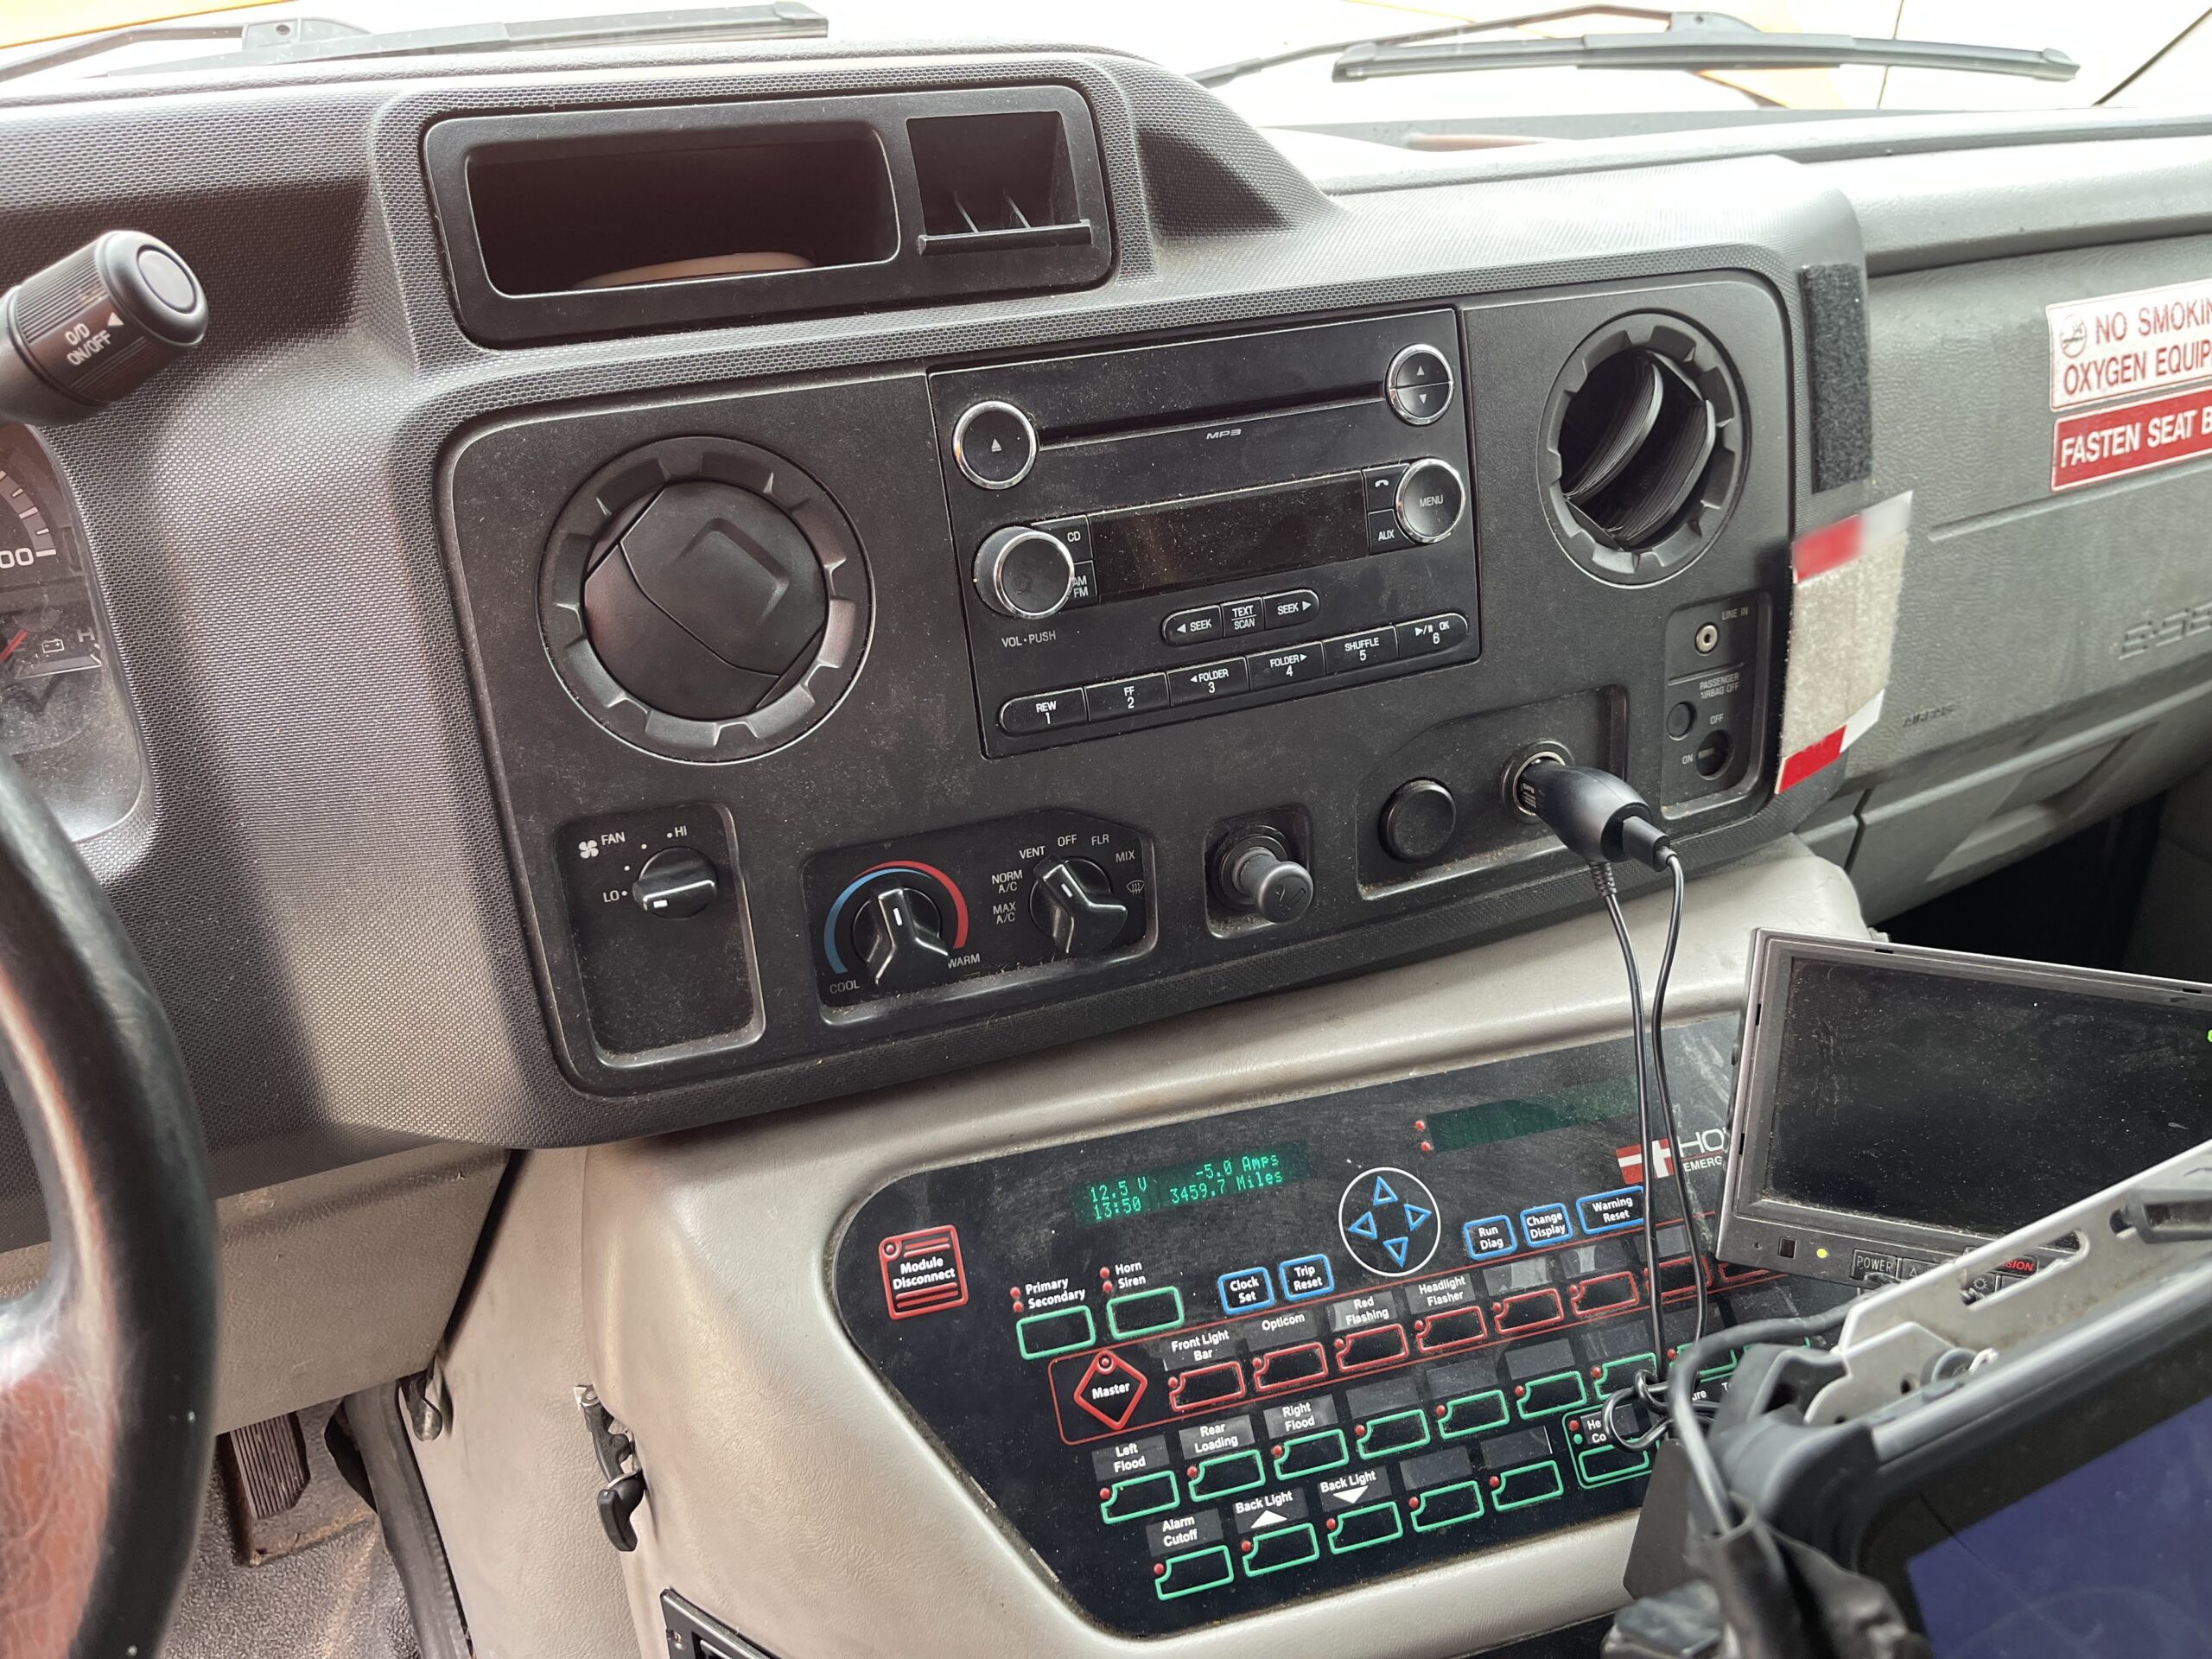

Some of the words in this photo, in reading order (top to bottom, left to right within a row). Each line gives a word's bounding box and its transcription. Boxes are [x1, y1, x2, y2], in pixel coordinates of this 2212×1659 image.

[65, 322, 91, 346] O/D
[2094, 311, 2127, 345] NO
[67, 329, 111, 365] ON/OFF
[2063, 351, 2146, 396] OXYGEN
[1206, 428, 1242, 440] MP3
[2060, 422, 2142, 468] FASTEN
[2146, 409, 2198, 448] SEAT
[1419, 494, 1444, 508] MENU
[1066, 531, 1081, 543] CD
[1377, 529, 1395, 542] AUX
[1071, 575, 1087, 588] AM
[1073, 587, 1089, 598] FM
[1232, 605, 1254, 618] TEXT
[1277, 602, 1299, 616] SEEK
[1721, 608, 1738, 620] LINE
[1740, 607, 1749, 616] IN
[1190, 619, 1212, 632] SEEK
[1234, 618, 1255, 631] SCAN
[1439, 620, 1450, 631] OK
[77, 626, 96, 643] H
[1432, 632, 1440, 645] 6
[1344, 637, 1380, 652] SHUFFLE
[1269, 653, 1300, 668] FOLDER
[1359, 650, 1367, 662] 5
[1198, 668, 1230, 683] FOLDER
[1285, 664, 1294, 677] 4
[1208, 682, 1216, 694] 3
[1700, 672, 1740, 691] PASSENGER
[1726, 682, 1740, 694] OFF
[1124, 686, 1135, 696] FF
[1036, 700, 1057, 714] REW
[1127, 696, 1135, 709] 2
[1045, 712, 1052, 725] 1
[1710, 713, 1724, 725] OFF
[1681, 755, 1694, 765] ON
[601, 831, 626, 846] FAN
[674, 825, 689, 837] HI
[1056, 833, 1078, 849] OFF
[1090, 833, 1110, 847] FLR
[1019, 845, 1046, 860] VENT
[1115, 849, 1136, 863] MIX
[991, 868, 1024, 885] NORM
[997, 881, 1018, 893] A/C
[602, 890, 620, 903] LO
[992, 900, 1017, 915] MAX
[995, 912, 1016, 925] A/C
[947, 953, 981, 969] WARM
[829, 979, 861, 995] COOL
[1090, 1180, 1128, 1203] 12.5
[1195, 1160, 1233, 1179] -5.0
[1242, 1154, 1280, 1173] Amps
[1093, 1195, 1141, 1221] 13:50
[1169, 1179, 1226, 1205] 3459.7
[1236, 1170, 1283, 1192] Miles
[1592, 1195, 1633, 1214] Warning
[1526, 1210, 1564, 1229] Change
[1603, 1208, 1630, 1224] Reset
[1478, 1225, 1499, 1236] Run
[1529, 1223, 1567, 1241] Display
[1479, 1236, 1504, 1251] Diag
[899, 1255, 944, 1275] Module
[1115, 1260, 1143, 1275] Horn
[1857, 1255, 1893, 1273] POWER
[893, 1267, 957, 1291] Disconnect
[1294, 1265, 1316, 1280] Trip
[1025, 1277, 1070, 1297] Primary
[1118, 1274, 1147, 1289] Siren
[1230, 1276, 1260, 1292] Clock
[1293, 1274, 1323, 1291] Reset
[1418, 1274, 1466, 1296] Headlight
[1028, 1287, 1086, 1310] Secondary
[1238, 1292, 1257, 1305] Set
[1353, 1295, 1375, 1310] Red
[1427, 1289, 1464, 1307] Flasher
[1261, 1311, 1306, 1332] Opticom
[1345, 1306, 1390, 1326] Flashing
[1171, 1336, 1199, 1353] Front
[1202, 1330, 1230, 1348] Light
[1194, 1348, 1213, 1363] Bar
[1091, 1382, 1131, 1401] Master
[1281, 1402, 1312, 1419] Right
[1199, 1422, 1226, 1438] Rear
[1284, 1414, 1316, 1433] Flood
[1115, 1442, 1139, 1459] Left
[1194, 1434, 1239, 1454] Loading
[1113, 1457, 1147, 1473] Flood
[1319, 1478, 1348, 1494] Back
[1350, 1470, 1377, 1487] Light
[1235, 1498, 1263, 1514] Back
[1265, 1491, 1294, 1508] Light
[1162, 1515, 1196, 1533] Alarm
[1163, 1529, 1198, 1548] Cutoff
